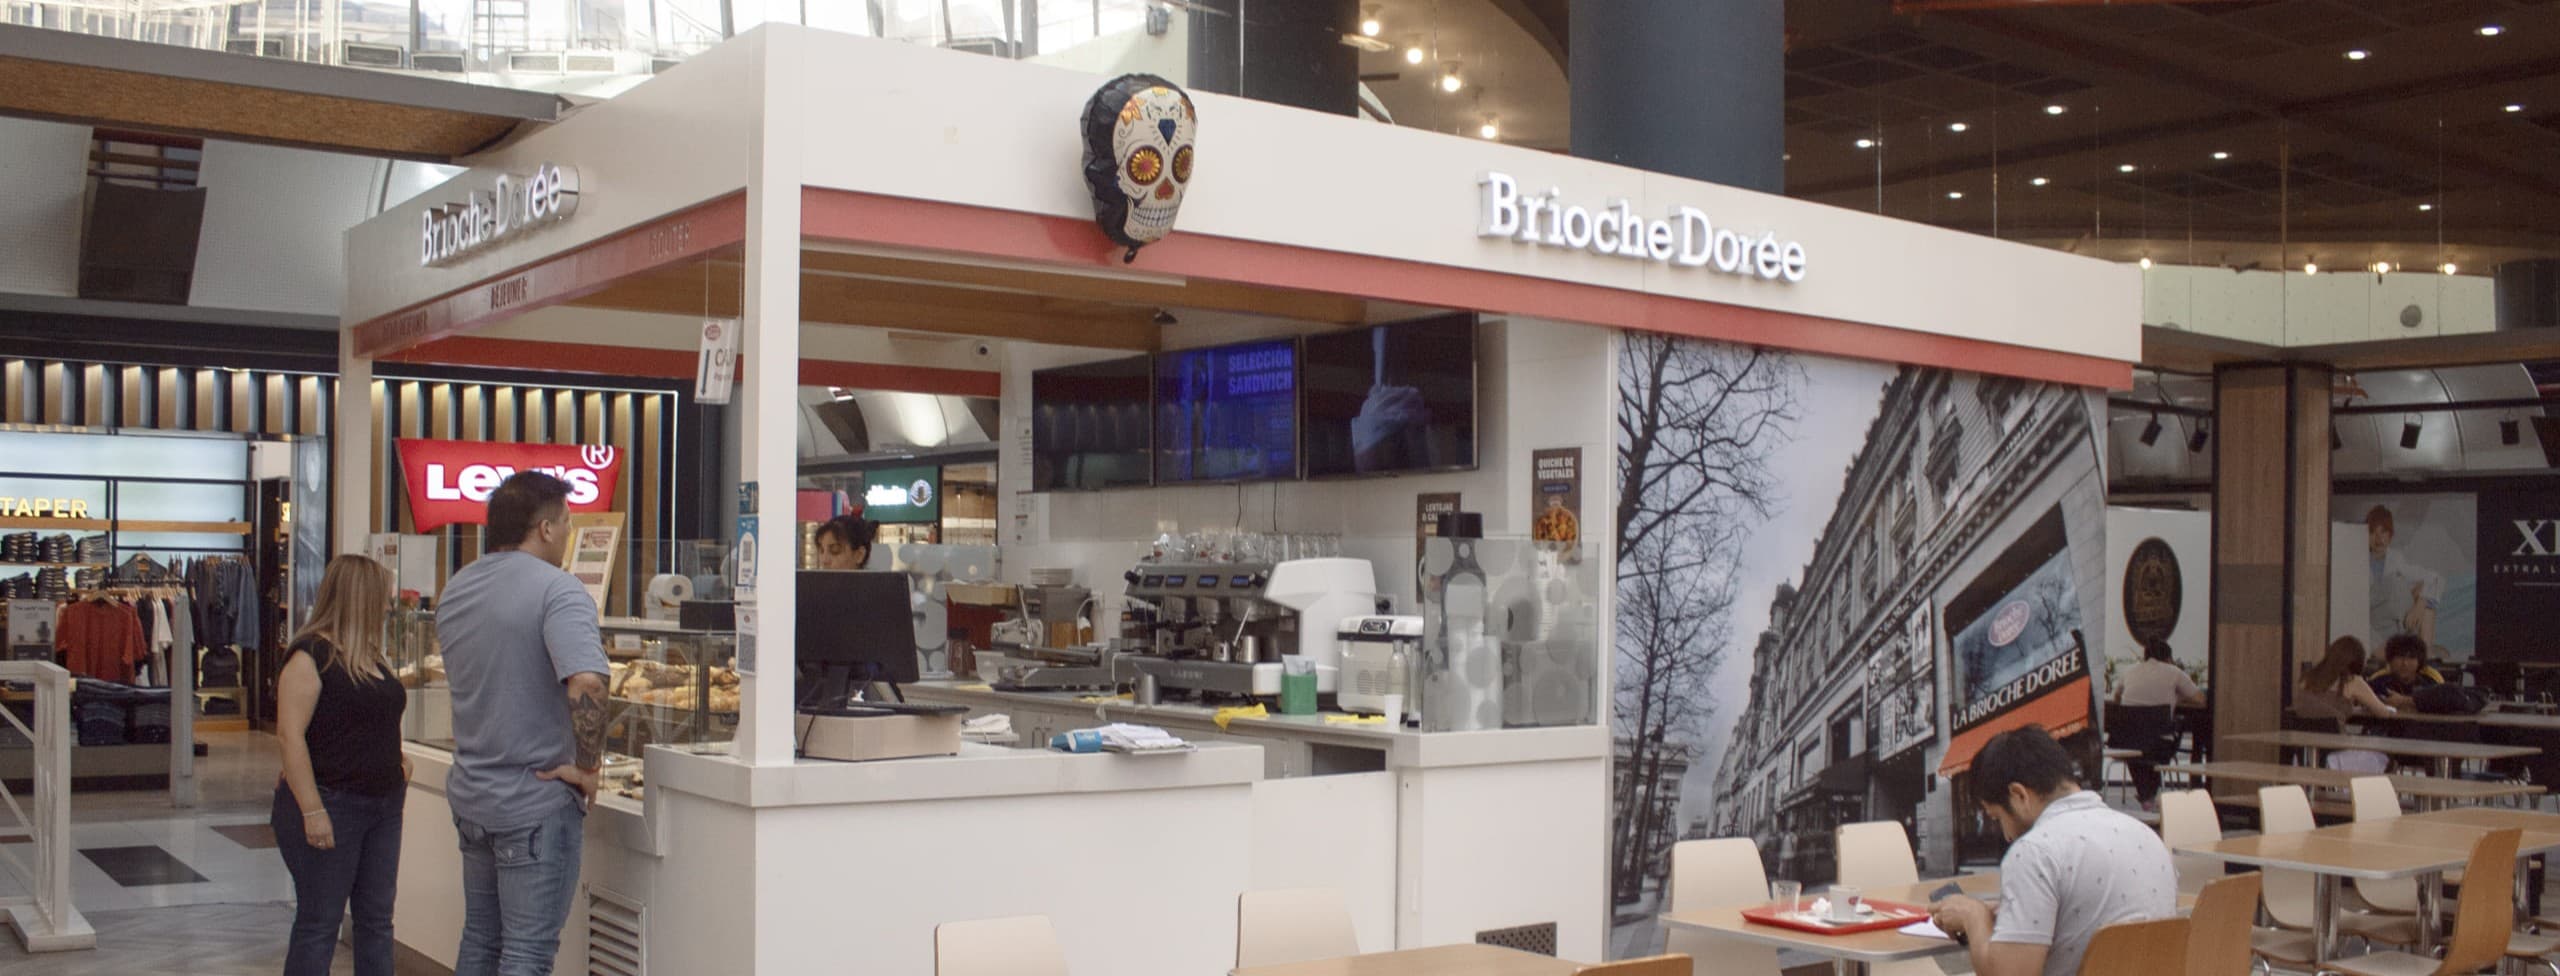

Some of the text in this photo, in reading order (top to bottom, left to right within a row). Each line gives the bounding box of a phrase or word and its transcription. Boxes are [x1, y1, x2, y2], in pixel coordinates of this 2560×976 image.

[421, 163, 562, 267] Brioche Dorée
[1485, 171, 1806, 282] Brioche Dorée
[1228, 371, 1293, 395] SANDWICH
[1537, 468, 1575, 480] VEGETALES
[1538, 457, 1575, 470] QUICHE DE
[0, 497, 88, 518] TAPER
[2493, 564, 2540, 574] EXTRA
[1952, 709, 1967, 730] LA
[1968, 677, 2025, 723] BRIOCHE
